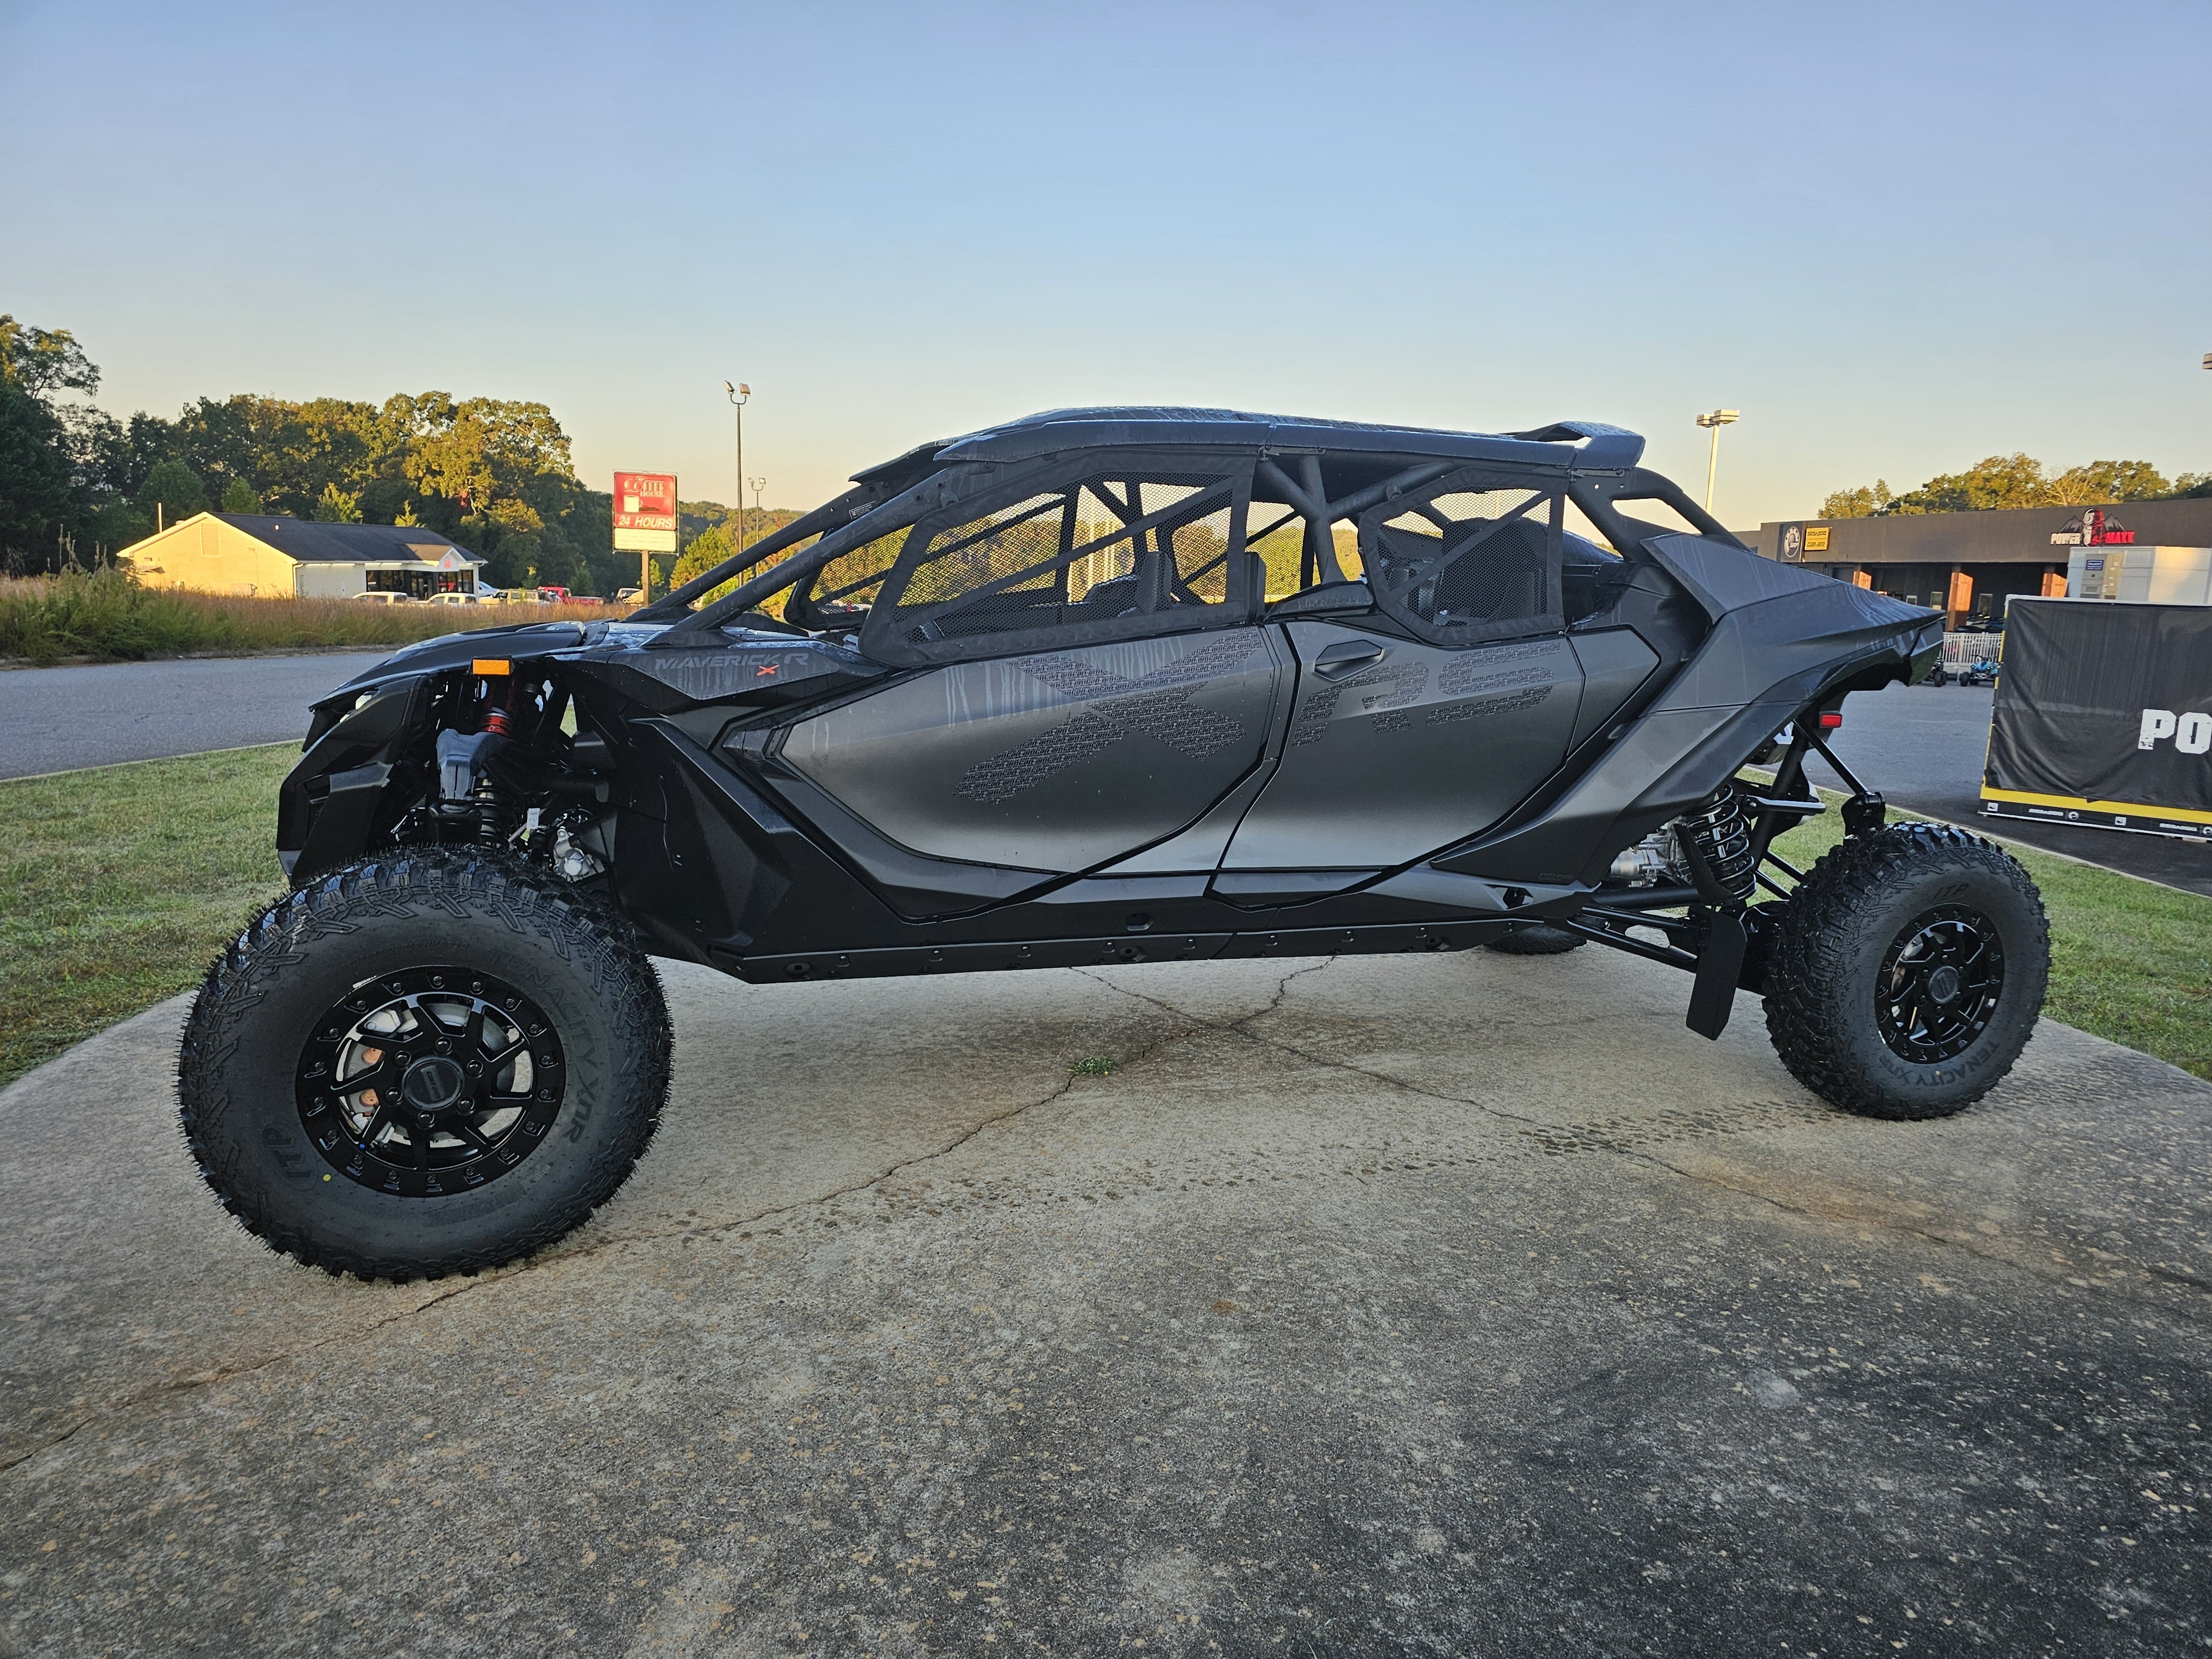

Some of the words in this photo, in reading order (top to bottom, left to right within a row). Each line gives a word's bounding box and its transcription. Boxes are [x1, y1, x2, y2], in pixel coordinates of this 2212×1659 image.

[624, 479, 664, 492] COFFEE
[618, 516, 631, 526] 24
[635, 517, 673, 529] HOURS
[2051, 533, 2081, 545] POWER
[2105, 531, 2135, 544] MAXX
[654, 653, 782, 671] MAVERICK
[784, 653, 810, 666] R
[757, 664, 780, 676] X
[1932, 883, 1970, 900] ITP
[1914, 1040, 2000, 1087] TENACITY
[262, 1127, 311, 1178] ITP
